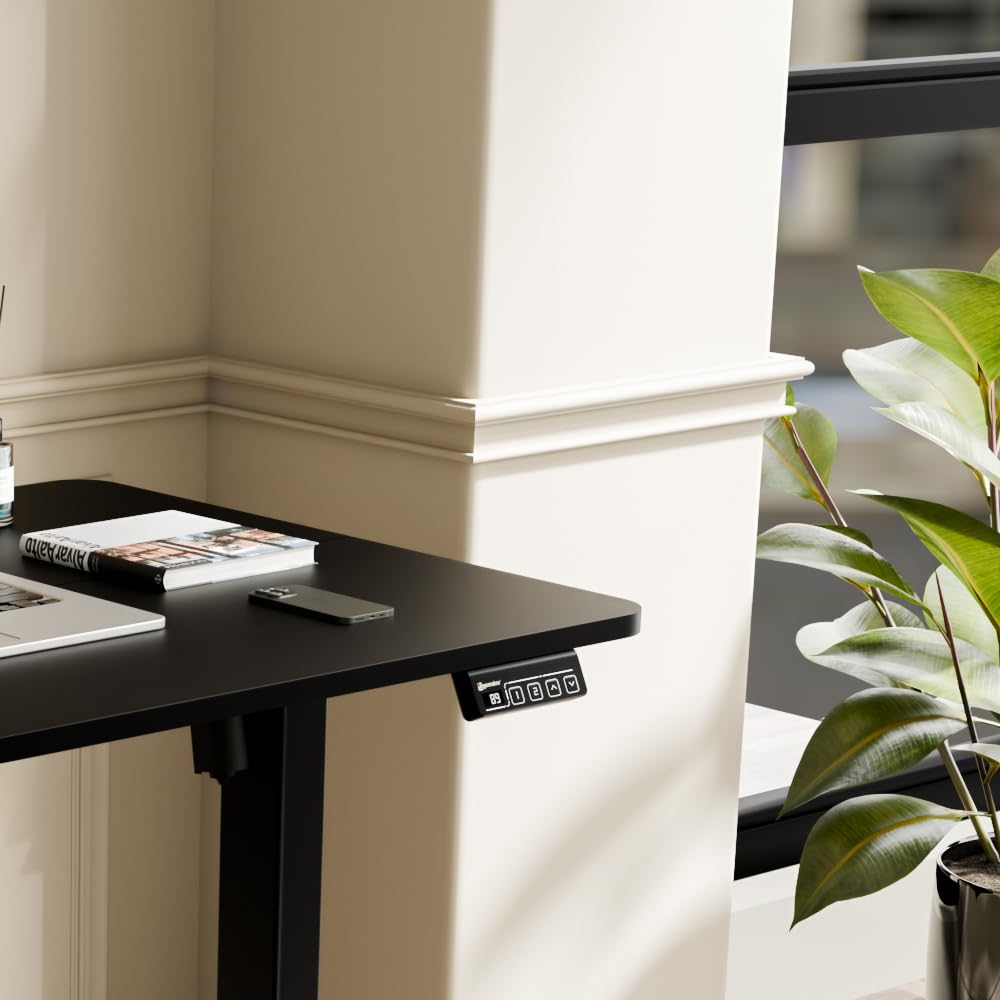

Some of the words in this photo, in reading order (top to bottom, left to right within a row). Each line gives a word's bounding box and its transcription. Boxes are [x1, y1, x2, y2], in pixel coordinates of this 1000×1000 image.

[26, 538, 57, 563] Aalto
[55, 546, 86, 568] Alvar
[489, 692, 502, 704] 89
[515, 691, 520, 700] 1
[532, 687, 540, 696] 2
